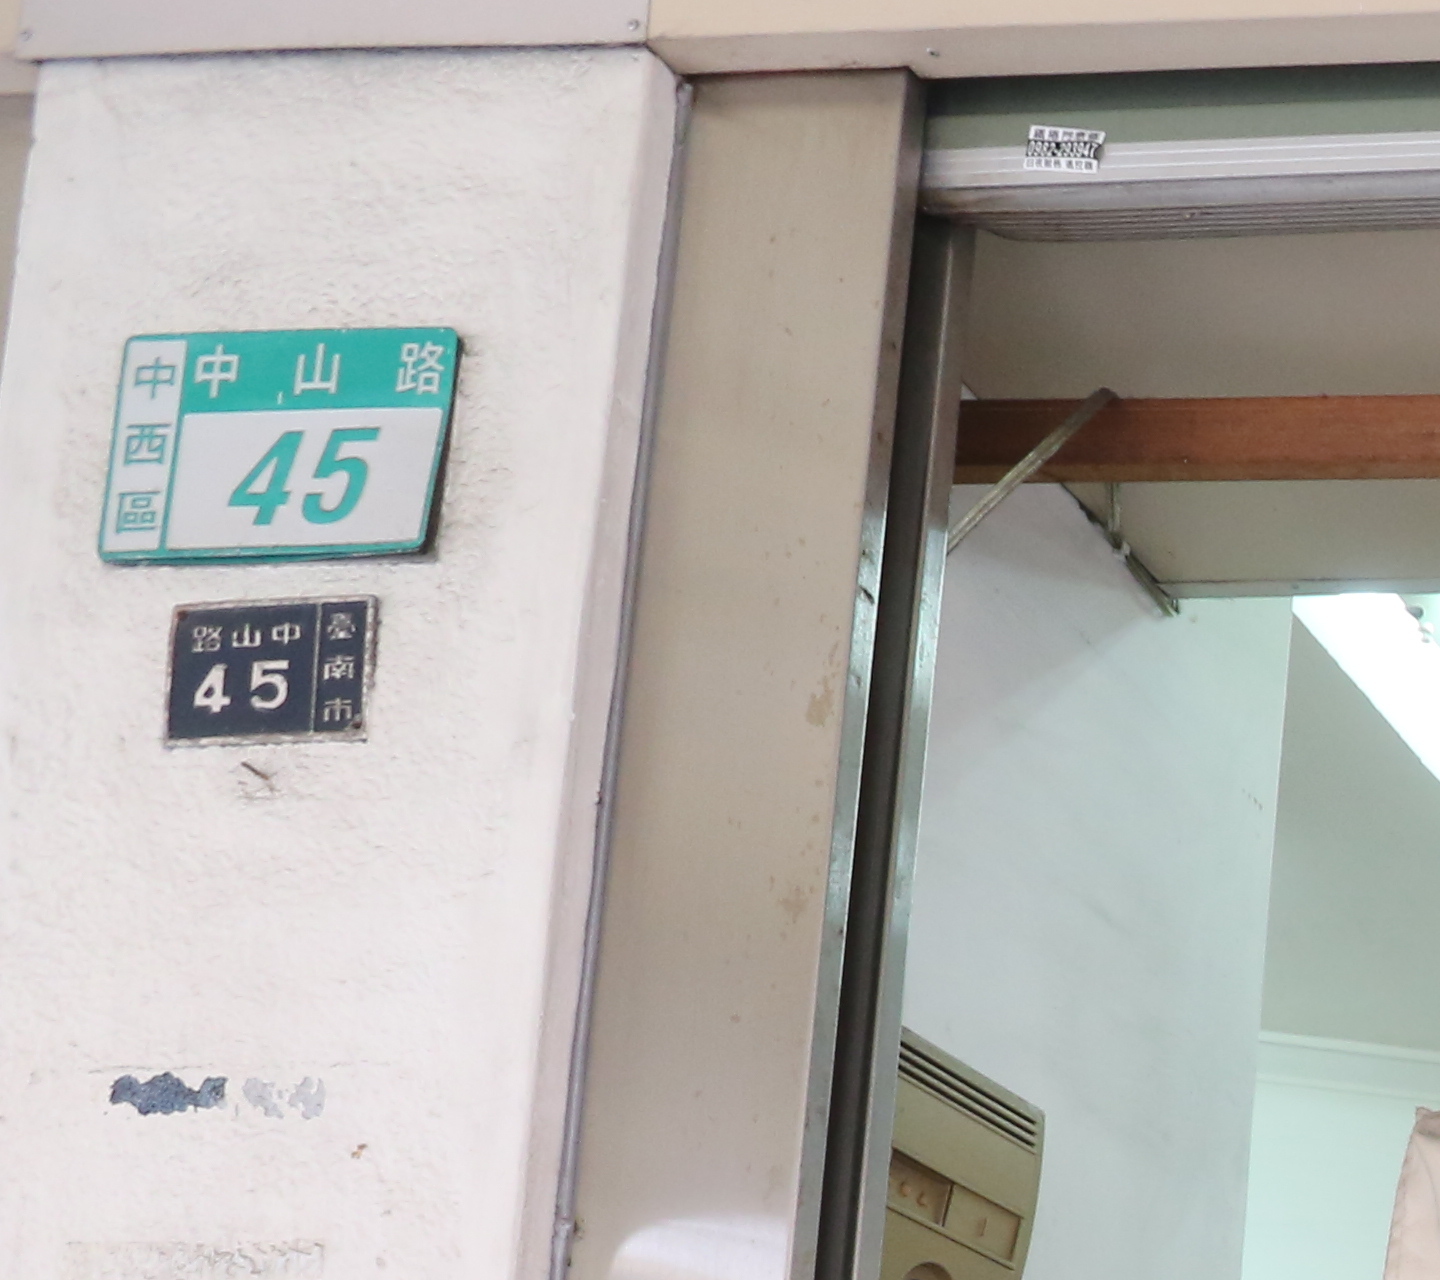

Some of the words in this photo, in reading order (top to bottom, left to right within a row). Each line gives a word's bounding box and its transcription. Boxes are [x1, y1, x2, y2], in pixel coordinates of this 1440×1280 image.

[193, 341, 445, 399] 中山路
[115, 355, 178, 536] 中西區
[227, 426, 380, 526] 45
[192, 659, 291, 715] 45
